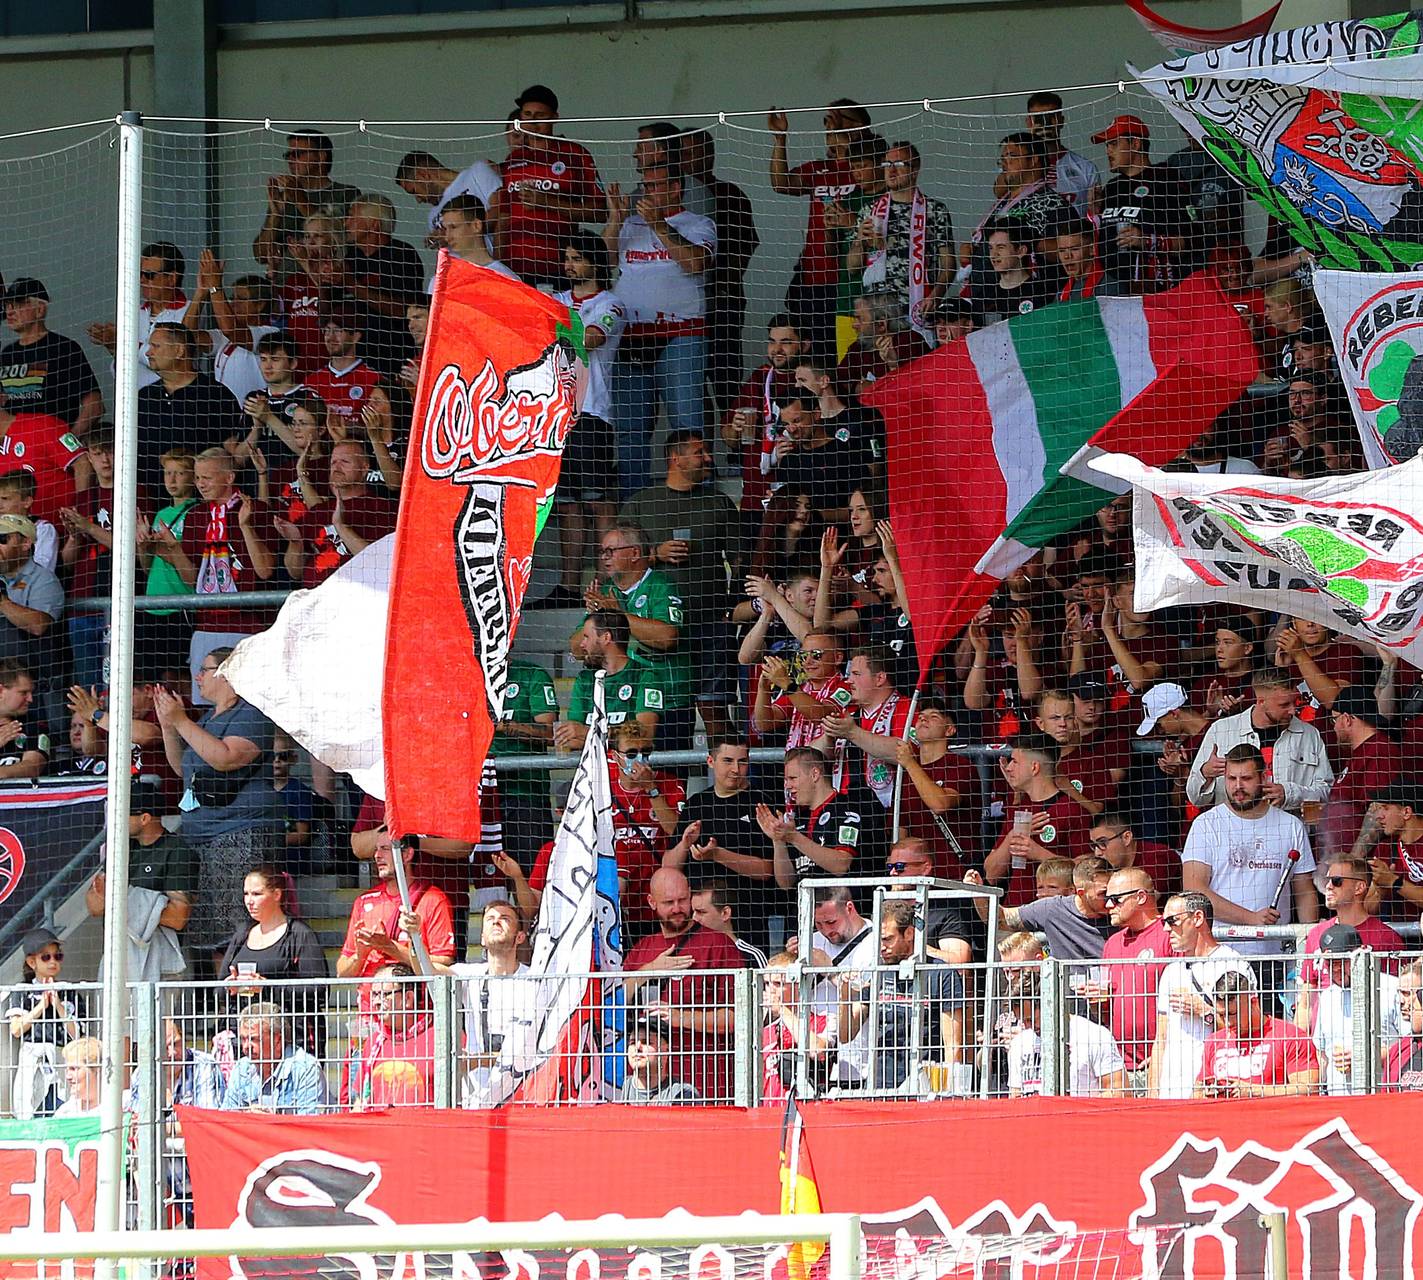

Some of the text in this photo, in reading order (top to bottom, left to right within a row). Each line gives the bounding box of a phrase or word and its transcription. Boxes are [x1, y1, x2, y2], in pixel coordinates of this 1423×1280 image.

[814, 184, 856, 197] evo
[1102, 206, 1141, 219] evo
[911, 213, 924, 287] RWO
